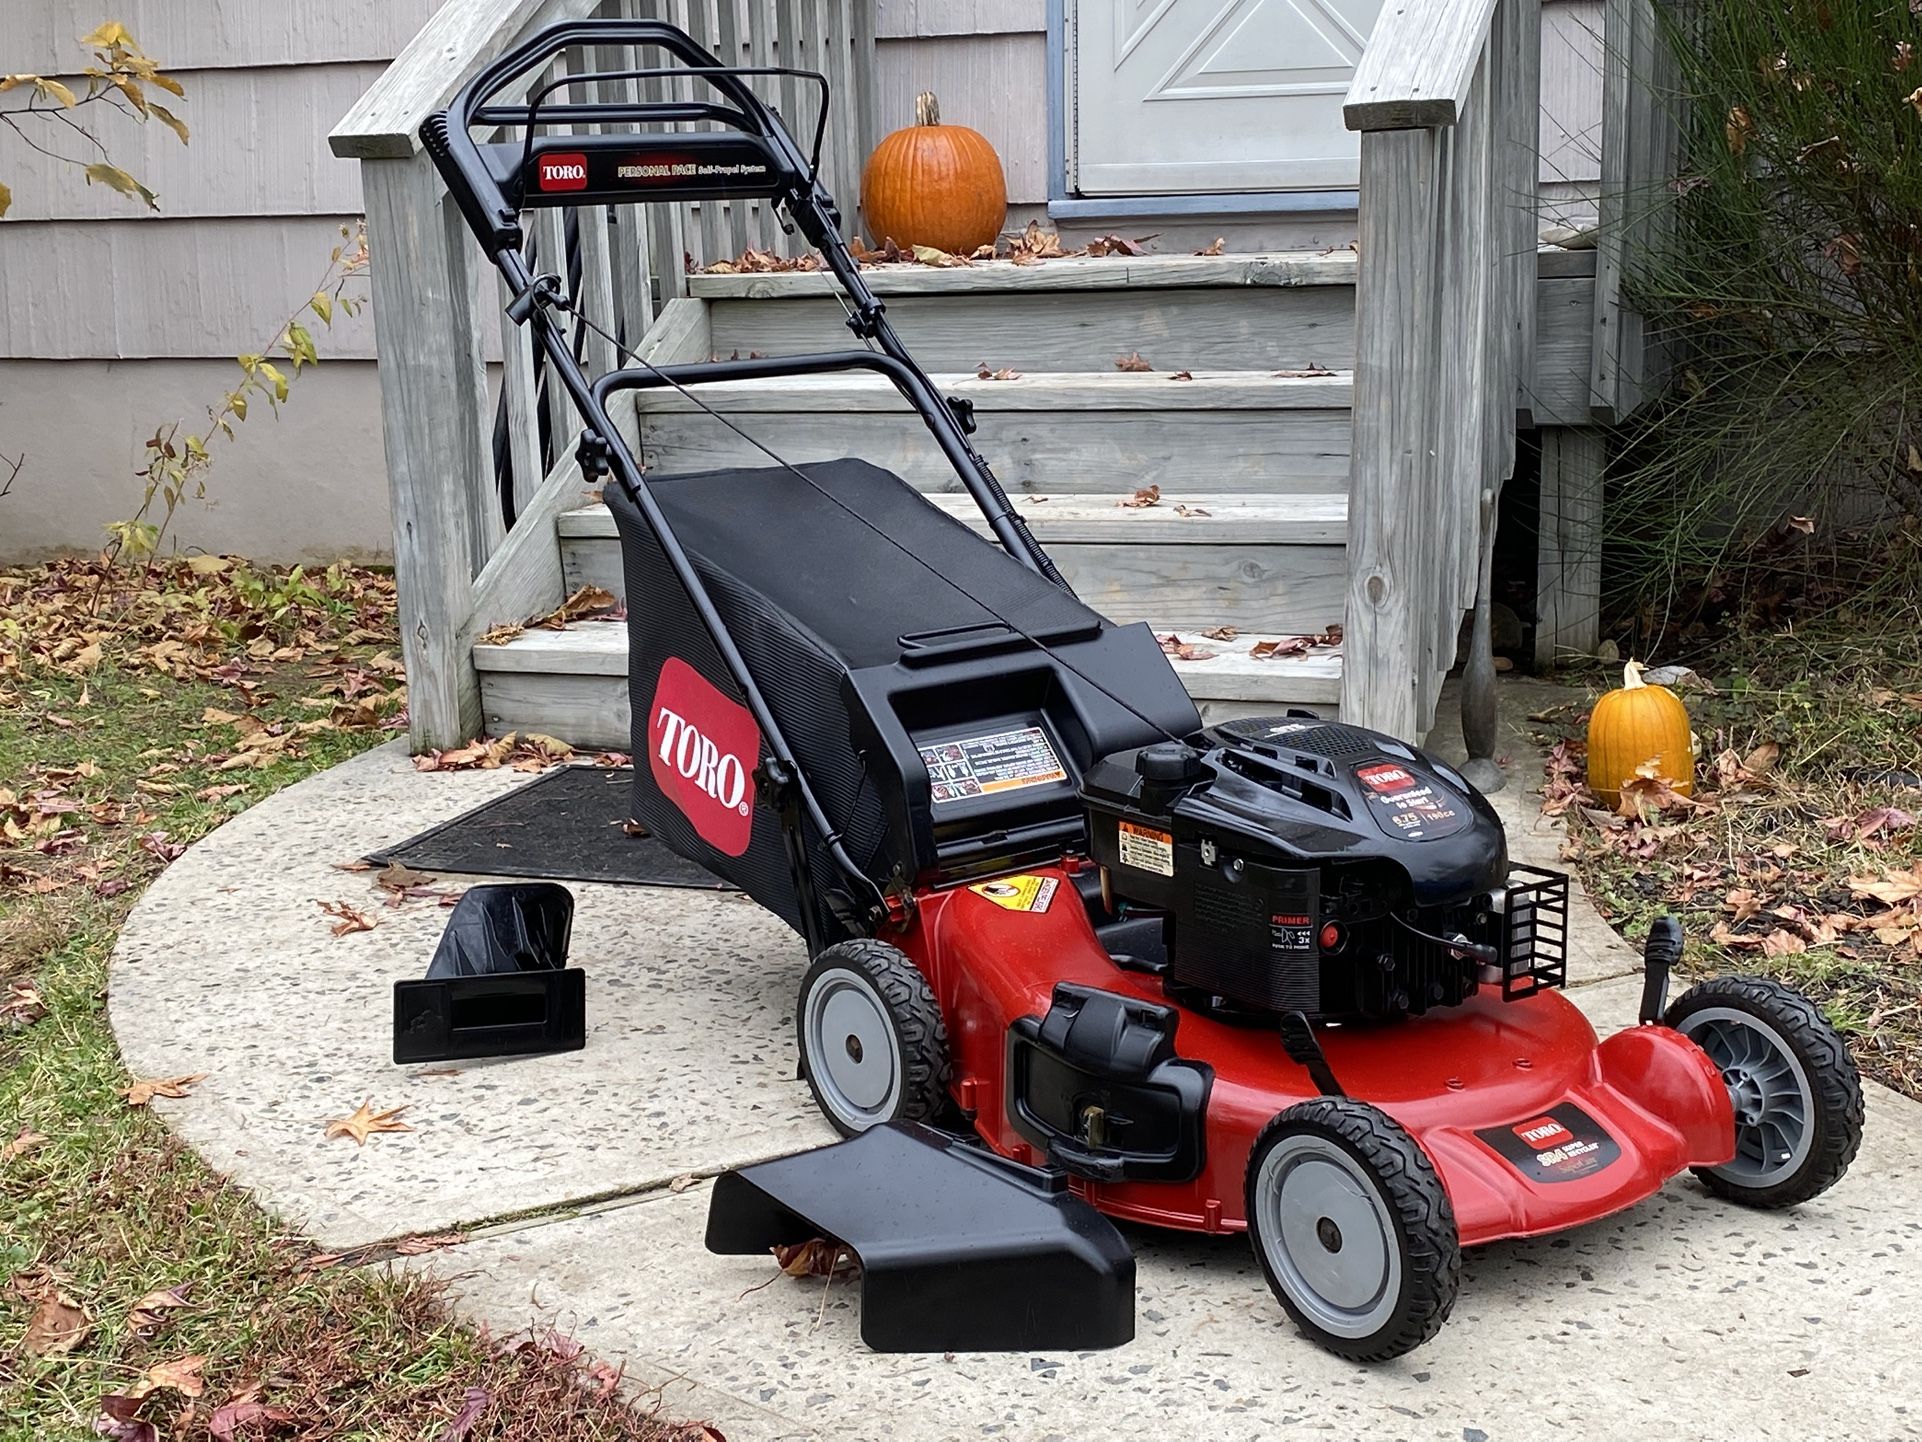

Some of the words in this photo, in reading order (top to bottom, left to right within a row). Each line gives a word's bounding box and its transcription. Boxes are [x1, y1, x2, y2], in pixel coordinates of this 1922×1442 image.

[542, 165, 584, 180] TORO
[617, 165, 670, 178] PERSONAL
[671, 164, 697, 176] PACE
[698, 164, 739, 175] Self-Propel
[740, 164, 767, 175] System
[1364, 769, 1406, 785] TORO
[1380, 786, 1433, 804] Guaranteed
[1406, 796, 1429, 807] Start
[1272, 915, 1310, 925] PRIMER
[1520, 1123, 1563, 1142] TORO
[1561, 1141, 1585, 1152] SUPER
